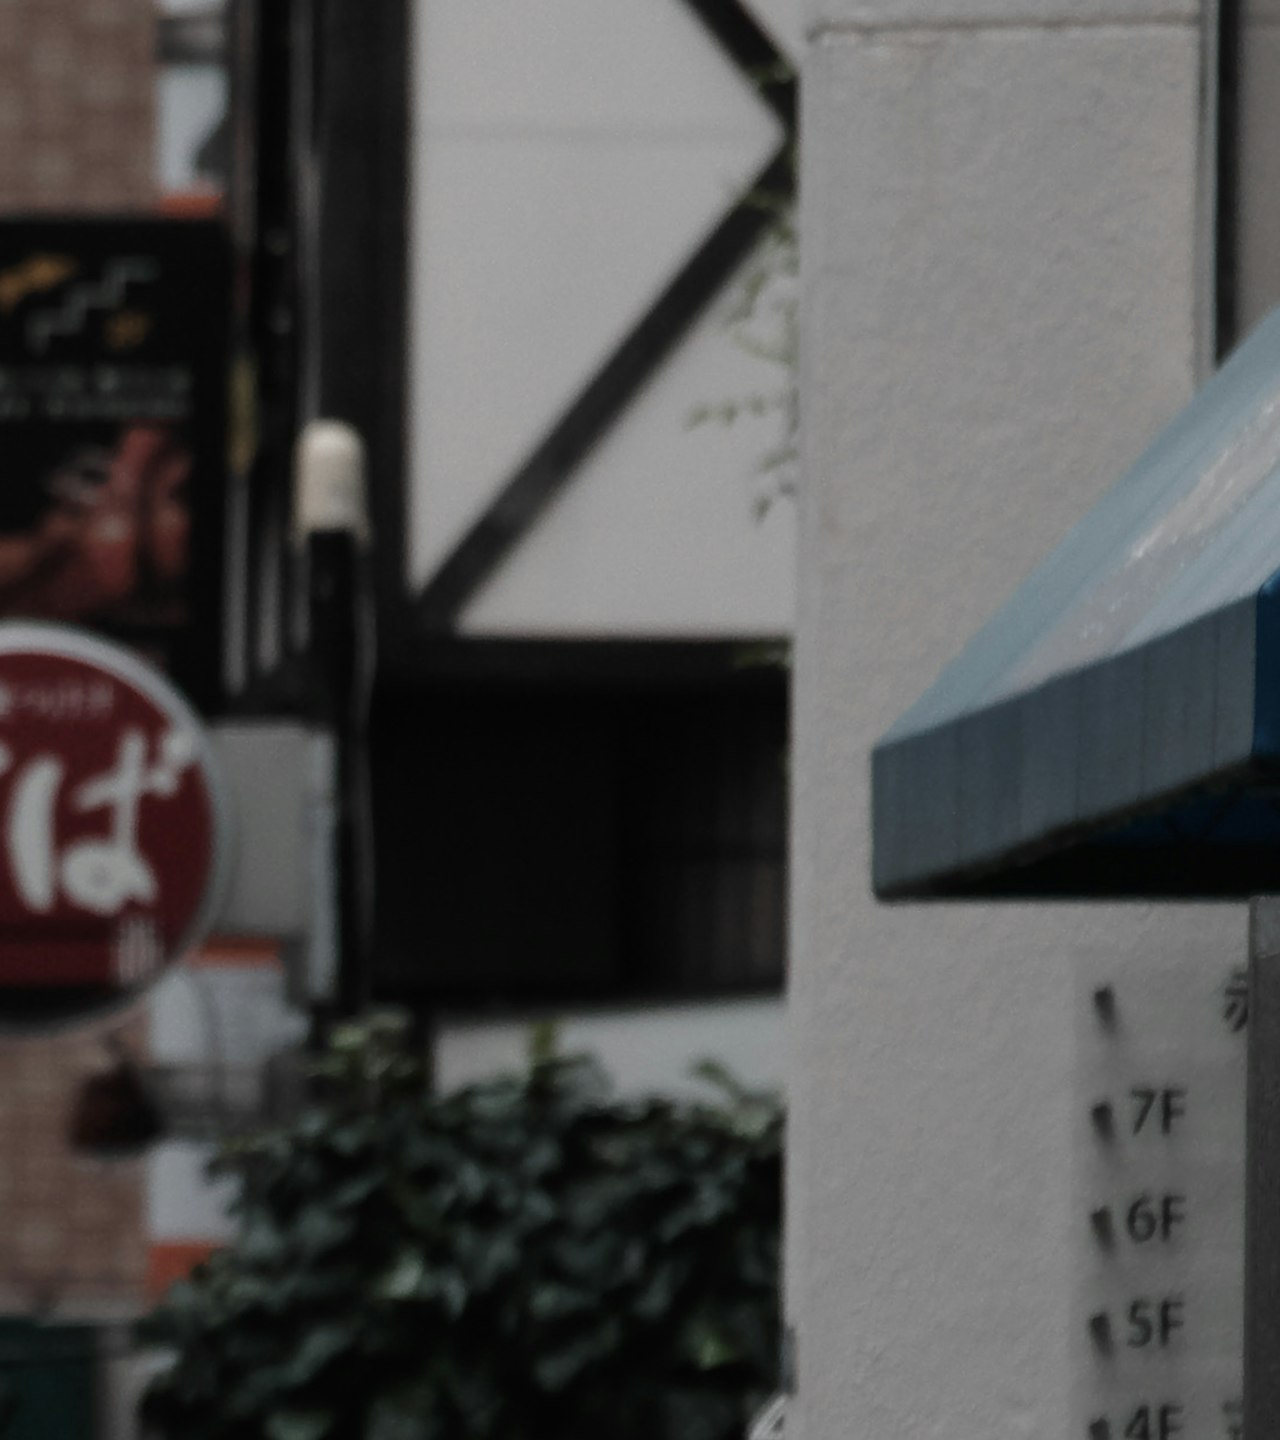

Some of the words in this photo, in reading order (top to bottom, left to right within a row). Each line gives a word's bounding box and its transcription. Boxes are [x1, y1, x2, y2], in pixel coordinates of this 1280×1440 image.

[1129, 1084, 1188, 1136] 7F
[1126, 1192, 1187, 1244] 6F
[1126, 1298, 1186, 1351] 5F
